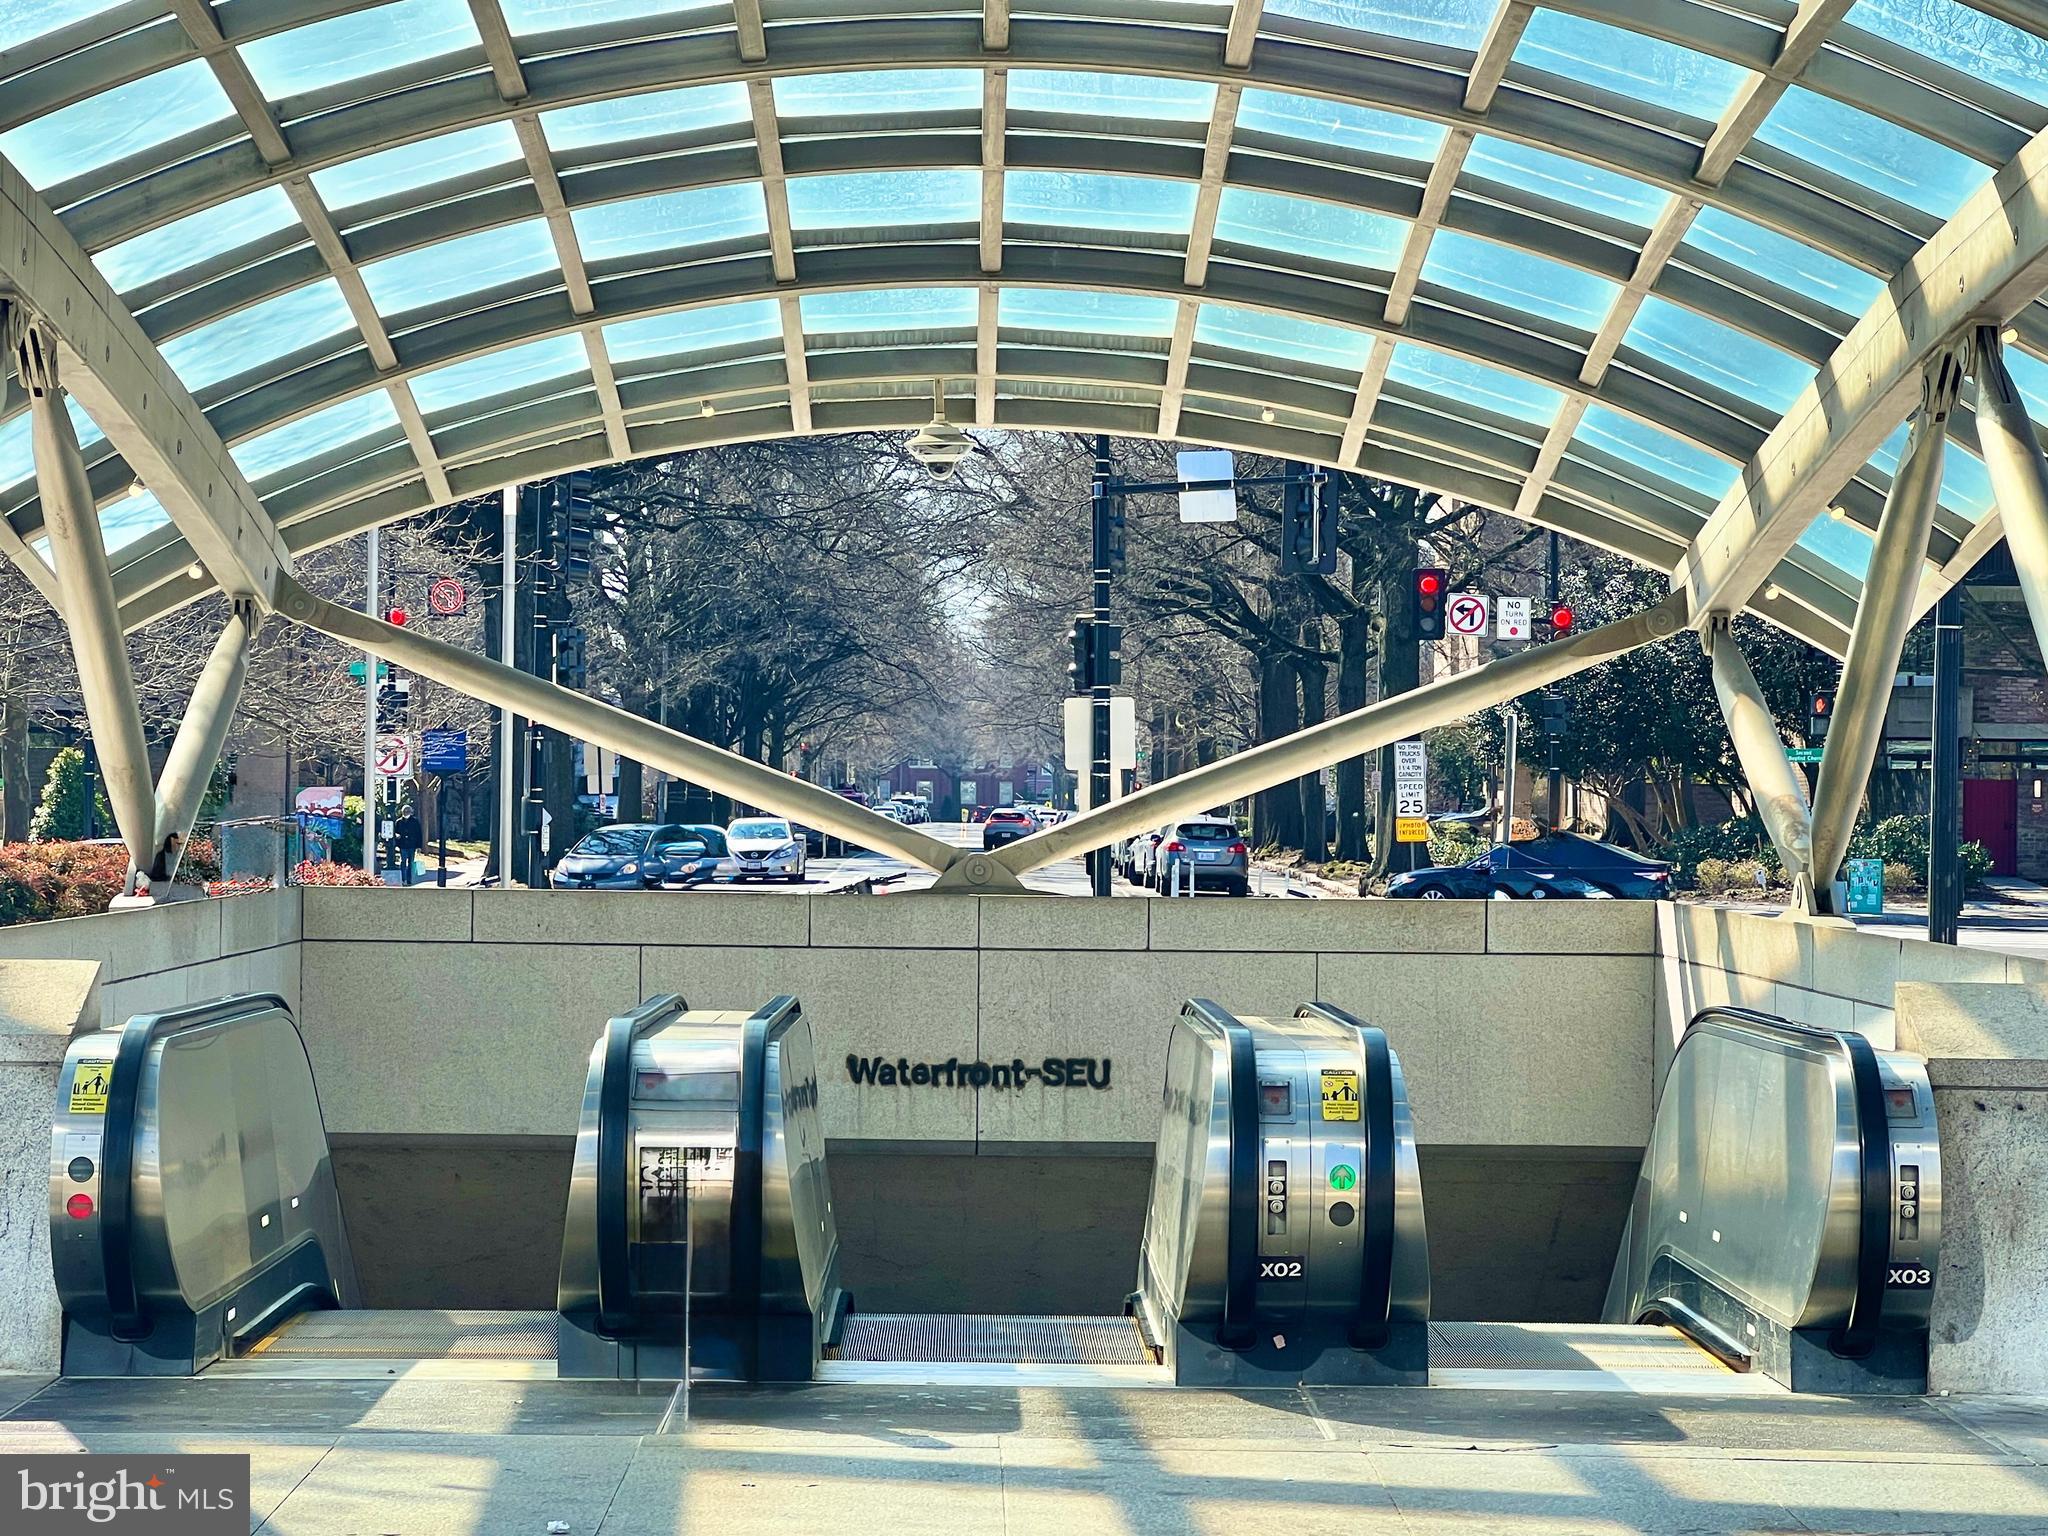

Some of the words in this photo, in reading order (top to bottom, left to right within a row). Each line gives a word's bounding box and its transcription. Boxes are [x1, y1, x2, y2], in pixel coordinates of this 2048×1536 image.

[1507, 601, 1521, 609] NO
[1399, 800, 1423, 814] 25
[846, 1053, 1112, 1090] Waterfront-SEU
